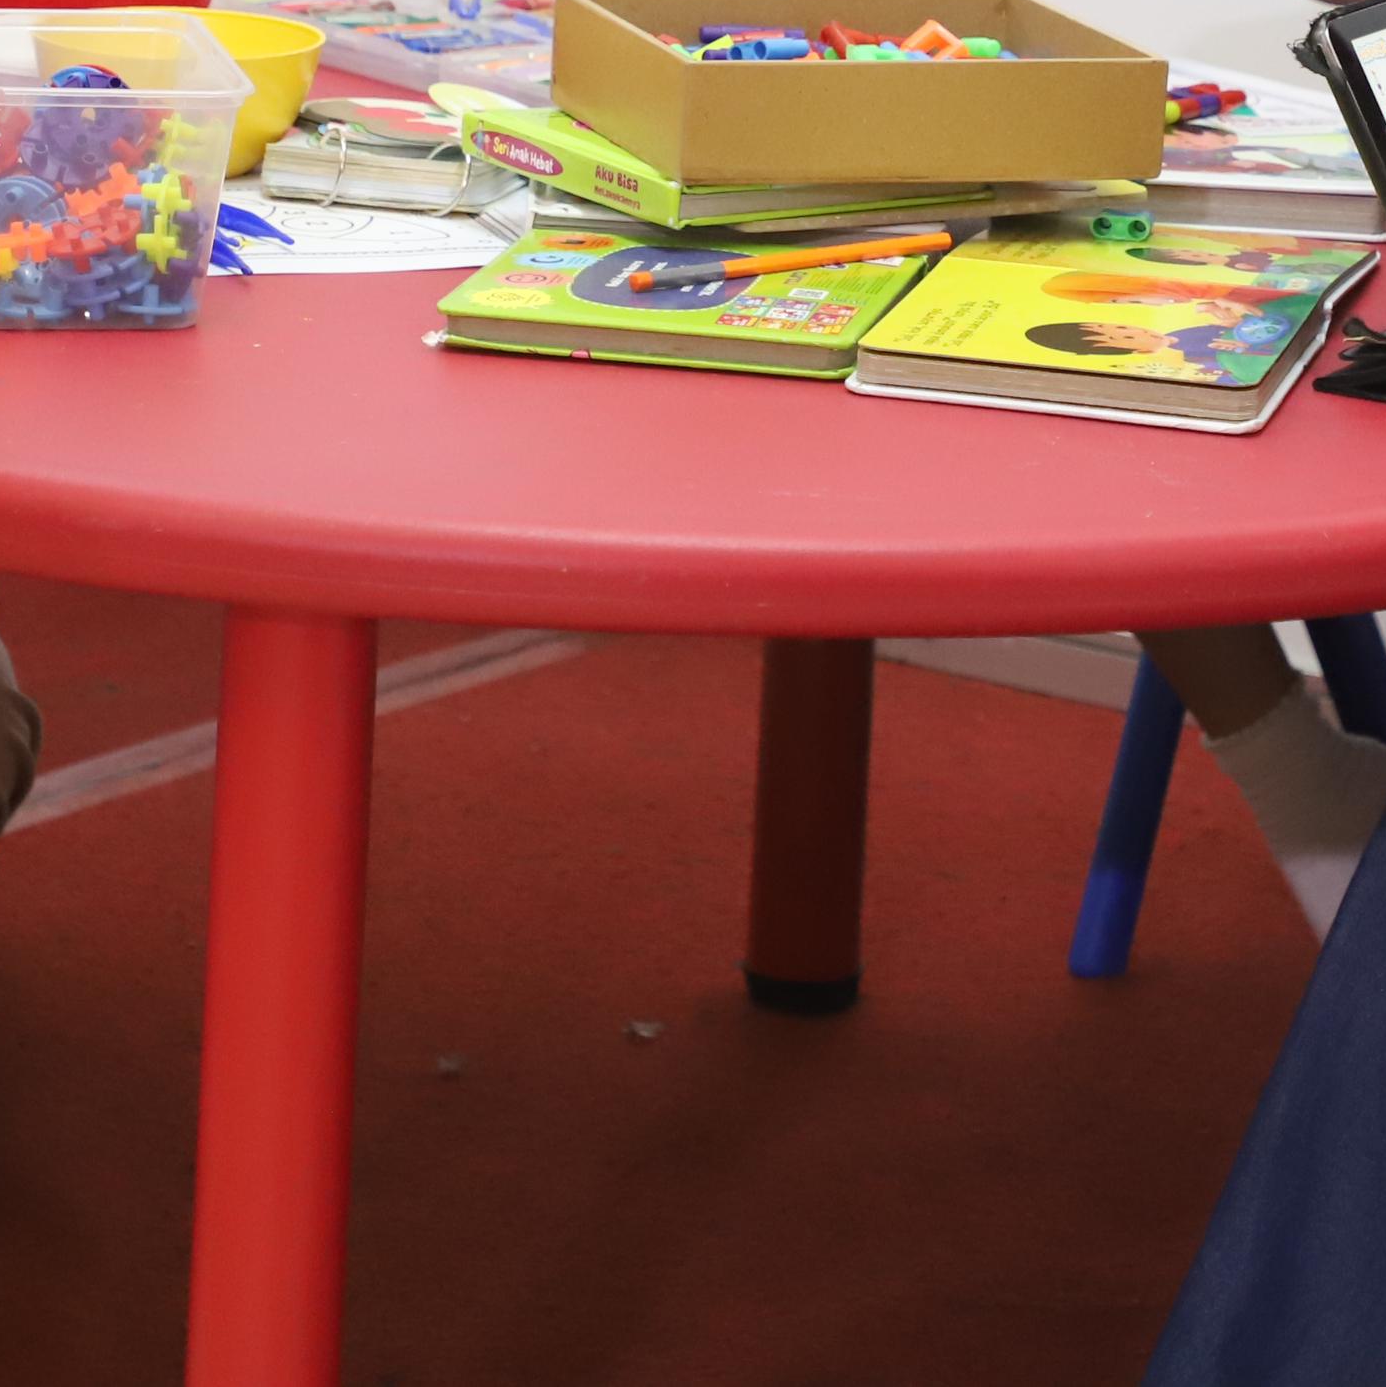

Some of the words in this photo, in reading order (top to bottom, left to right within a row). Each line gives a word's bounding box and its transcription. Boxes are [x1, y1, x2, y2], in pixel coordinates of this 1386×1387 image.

[493, 136, 510, 158] Seri
[509, 144, 530, 165] Anak
[529, 152, 554, 174] Hebat
[617, 172, 639, 193] Bisa
